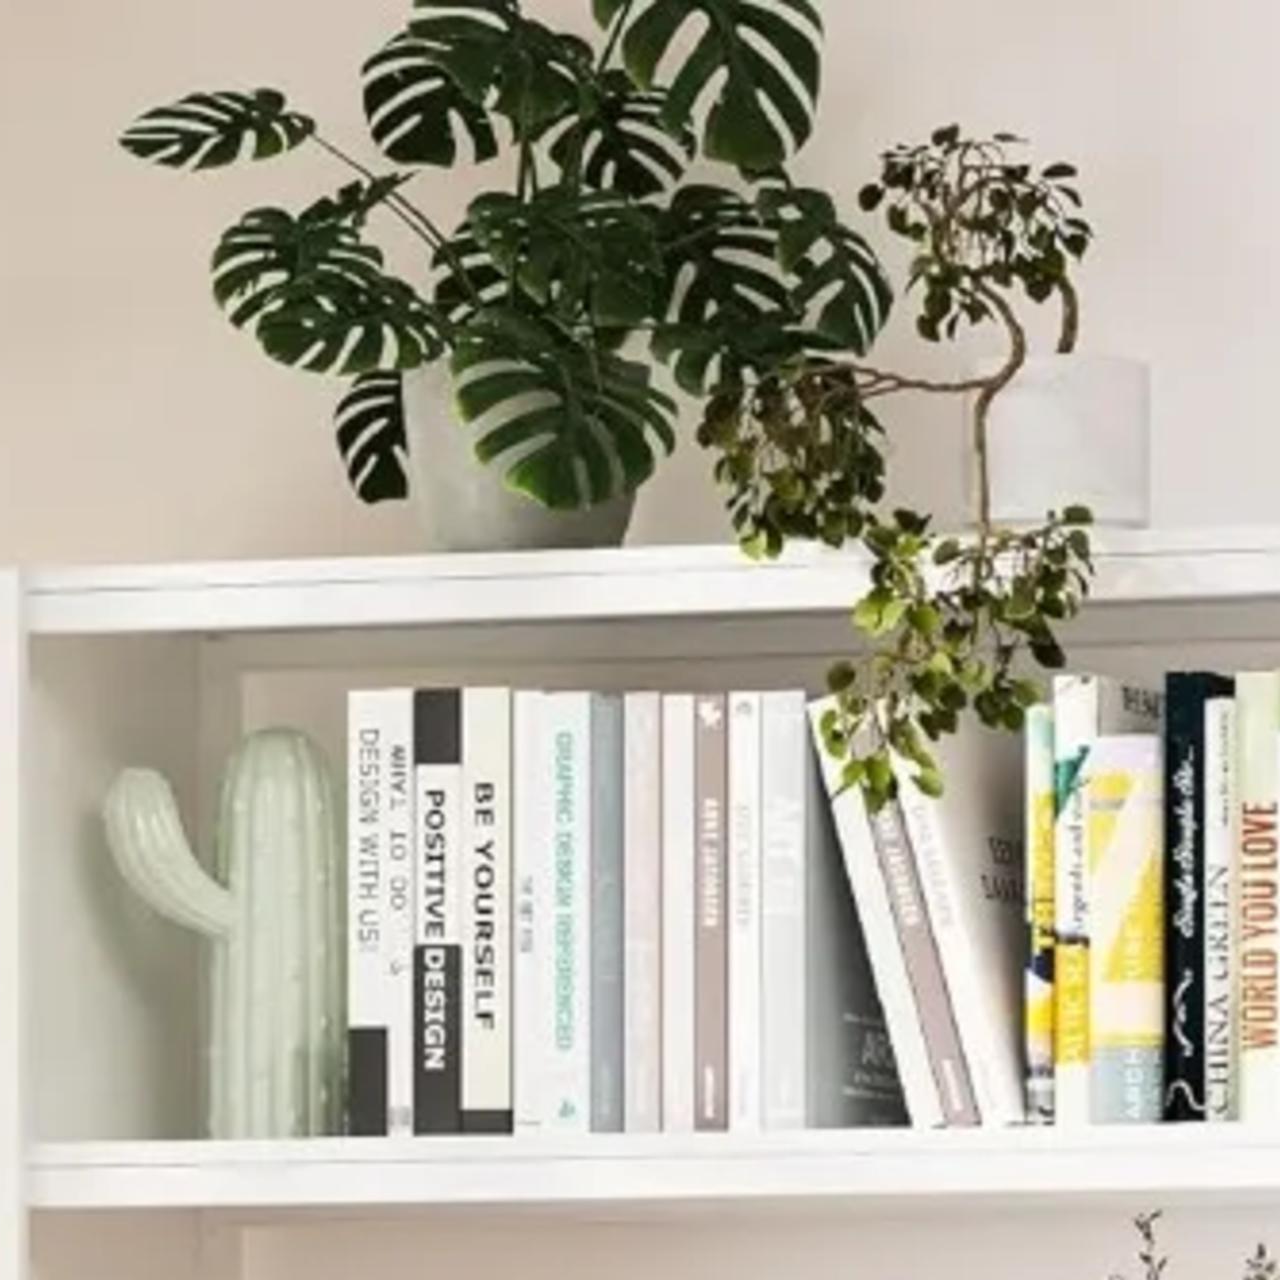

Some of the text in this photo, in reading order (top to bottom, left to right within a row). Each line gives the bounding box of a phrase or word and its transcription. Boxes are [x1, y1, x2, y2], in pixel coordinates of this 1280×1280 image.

[359, 832, 380, 900] WITH
[424, 789, 446, 1071] POSITIVE DESIGN
[474, 782, 495, 1031] BE YOURSELF
[1207, 865, 1230, 1115] CHINA GREEN
[1242, 801, 1277, 1050] WORLD YOU LOVE
